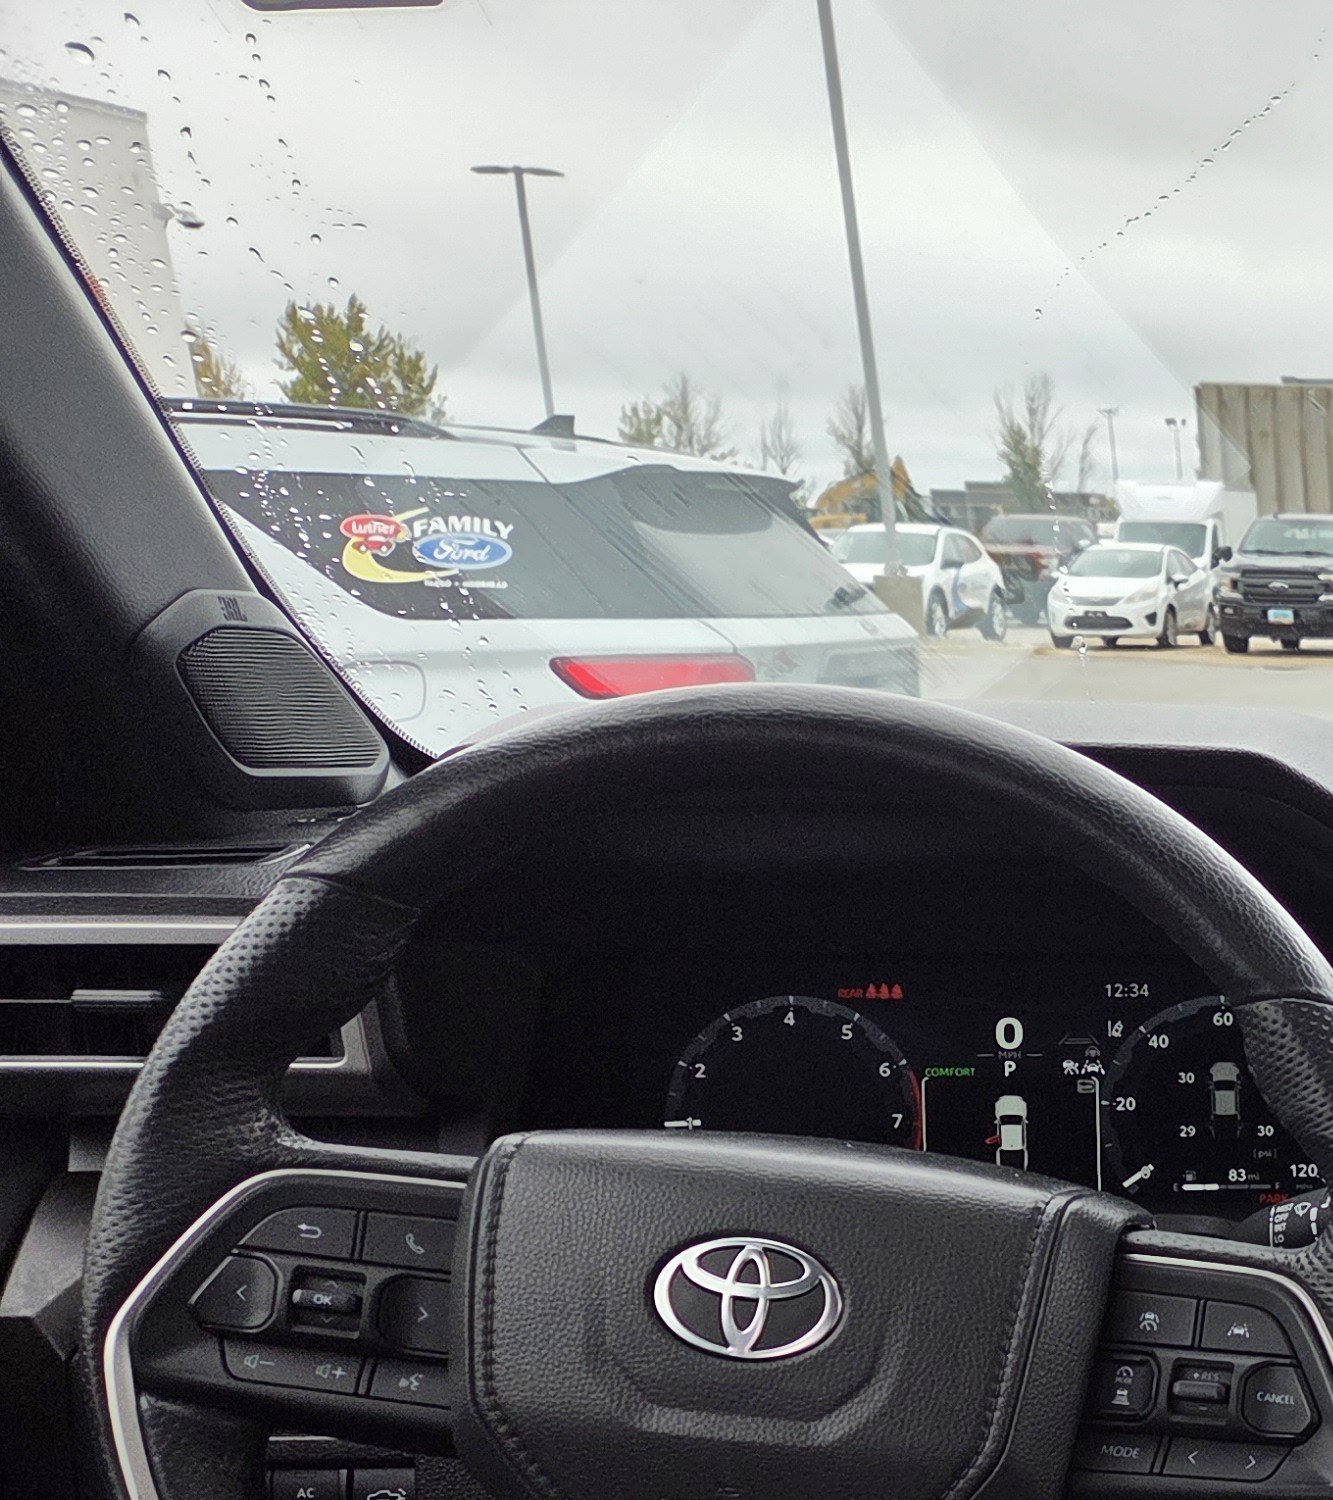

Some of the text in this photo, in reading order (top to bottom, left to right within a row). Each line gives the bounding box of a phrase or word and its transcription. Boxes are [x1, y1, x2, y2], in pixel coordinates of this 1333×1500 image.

[412, 515, 514, 540] FAMILY
[433, 537, 492, 562] Ford
[1105, 983, 1149, 998] 12:34
[783, 1011, 796, 1027] 4
[1212, 1012, 1233, 1027] 60
[732, 1025, 743, 1042] 3
[841, 1024, 853, 1040] 5
[995, 1016, 1024, 1050] 0
[1148, 1034, 1169, 1049] 40
[694, 1063, 706, 1079] 2
[879, 1062, 891, 1077] 6
[925, 1067, 976, 1078] COMFORT
[1004, 1060, 1017, 1077] P
[1178, 1072, 1195, 1084] 30
[1116, 1096, 1136, 1112] 20
[891, 1113, 903, 1129] 7
[1179, 1125, 1196, 1137] 29
[1257, 1125, 1274, 1137] 30
[1228, 1168, 1246, 1182] 83
[1289, 1163, 1318, 1178] 120
[313, 1295, 332, 1306] OK
[1256, 1391, 1295, 1405] CANCEL
[1101, 1444, 1140, 1459] MODE
[296, 1488, 315, 1499] AC
